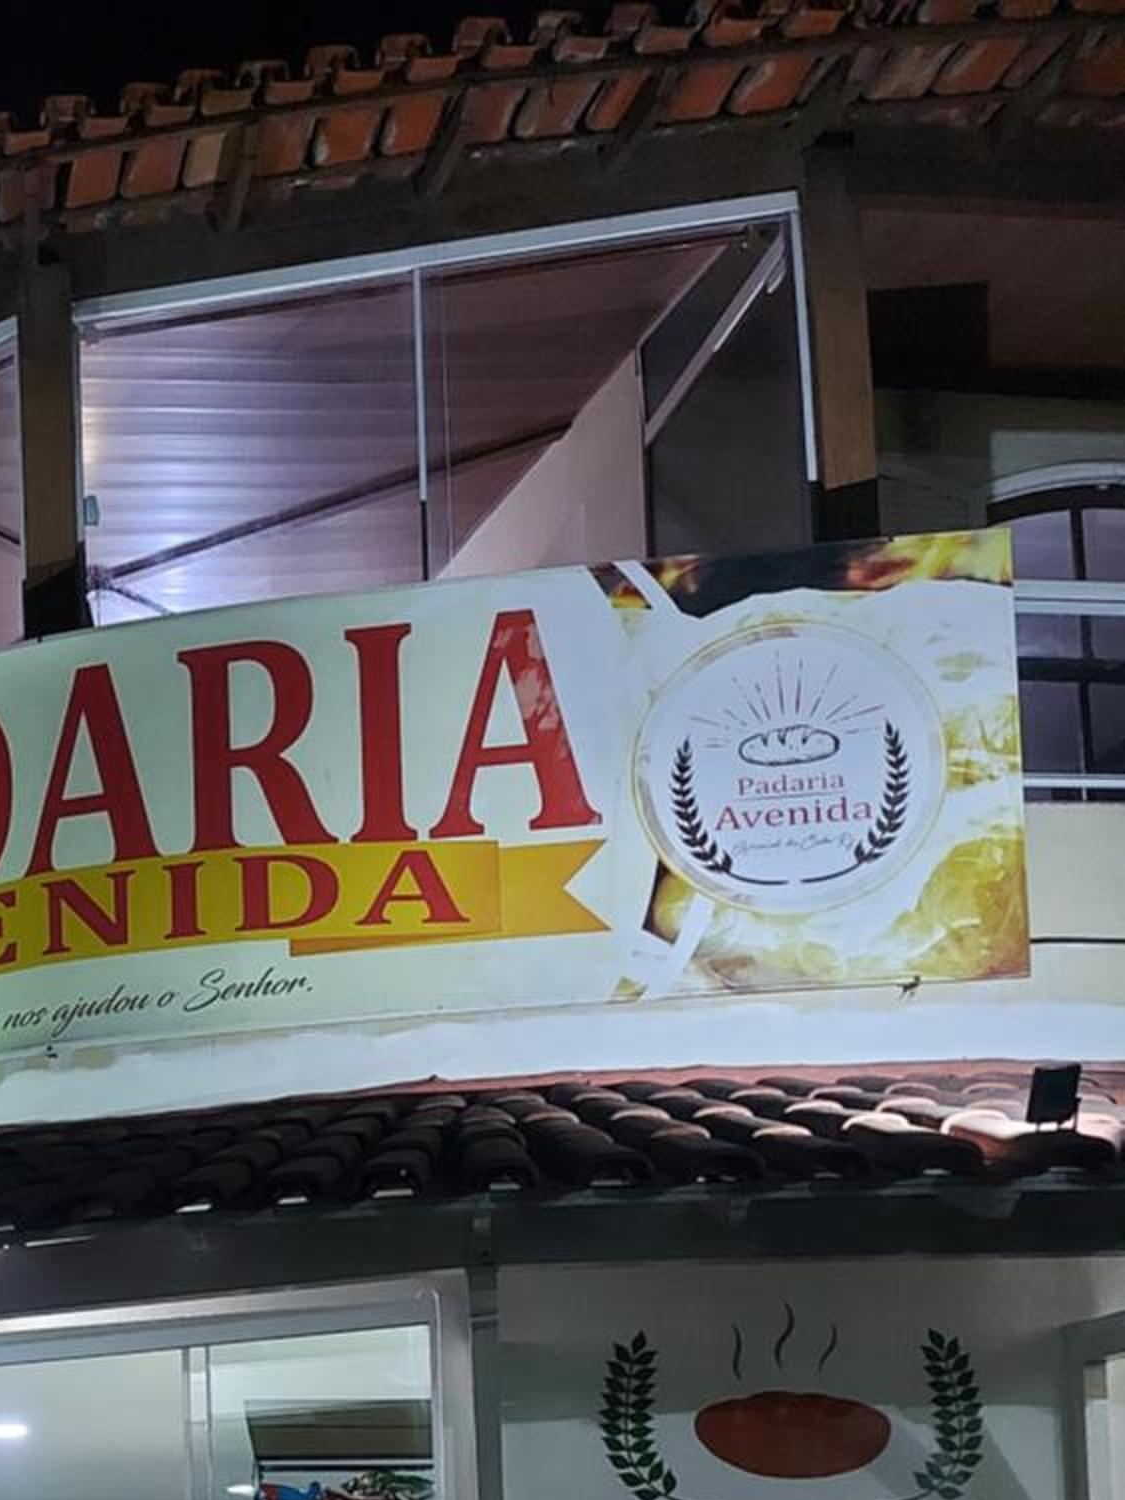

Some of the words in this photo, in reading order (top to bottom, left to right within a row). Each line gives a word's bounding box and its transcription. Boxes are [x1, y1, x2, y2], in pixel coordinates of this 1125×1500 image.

[737, 772, 844, 796] Padaria
[714, 797, 873, 831] Avenida
[3, 1006, 48, 1030] nos
[51, 984, 151, 1039] ajudou
[156, 990, 175, 1009] o
[182, 967, 313, 1013] Senhor.
